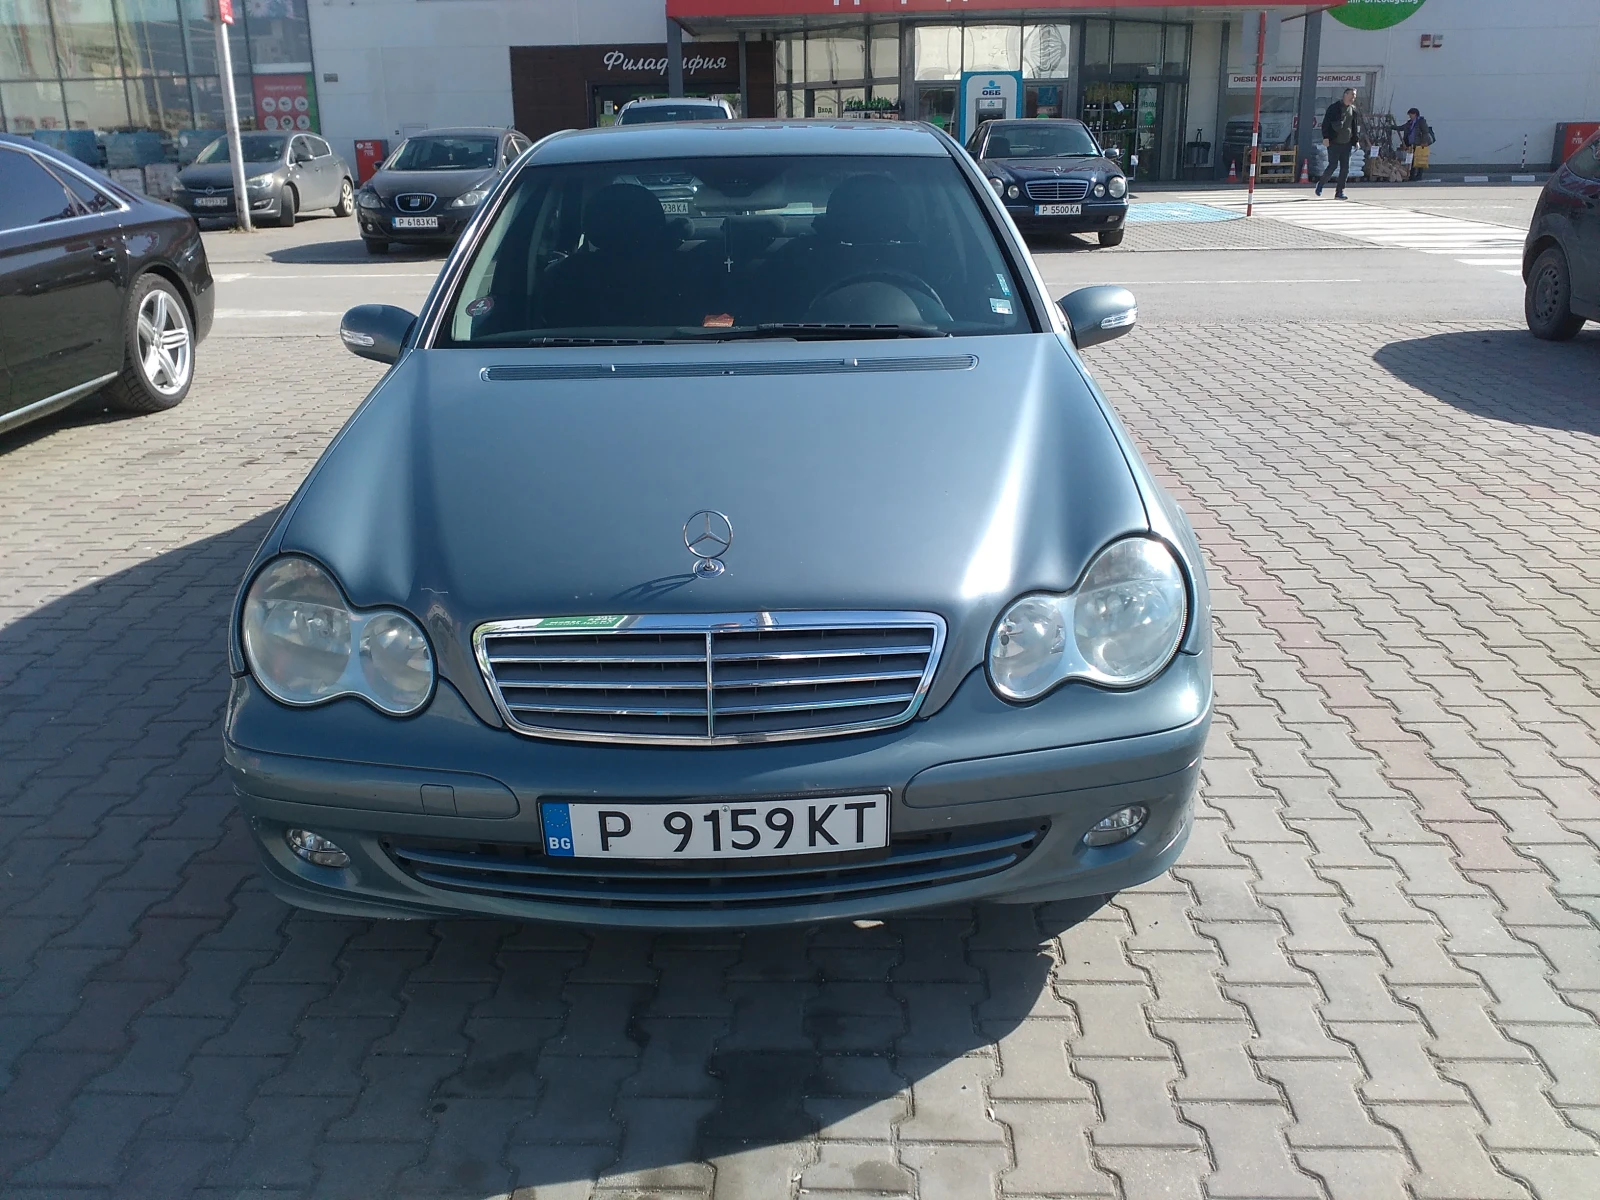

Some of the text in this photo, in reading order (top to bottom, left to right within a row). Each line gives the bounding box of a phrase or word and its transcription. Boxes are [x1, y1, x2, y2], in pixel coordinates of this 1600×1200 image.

[603, 50, 727, 75] Филадфия
[817, 106, 833, 114] Вход
[598, 810, 632, 851] P
[549, 837, 571, 850] BG
